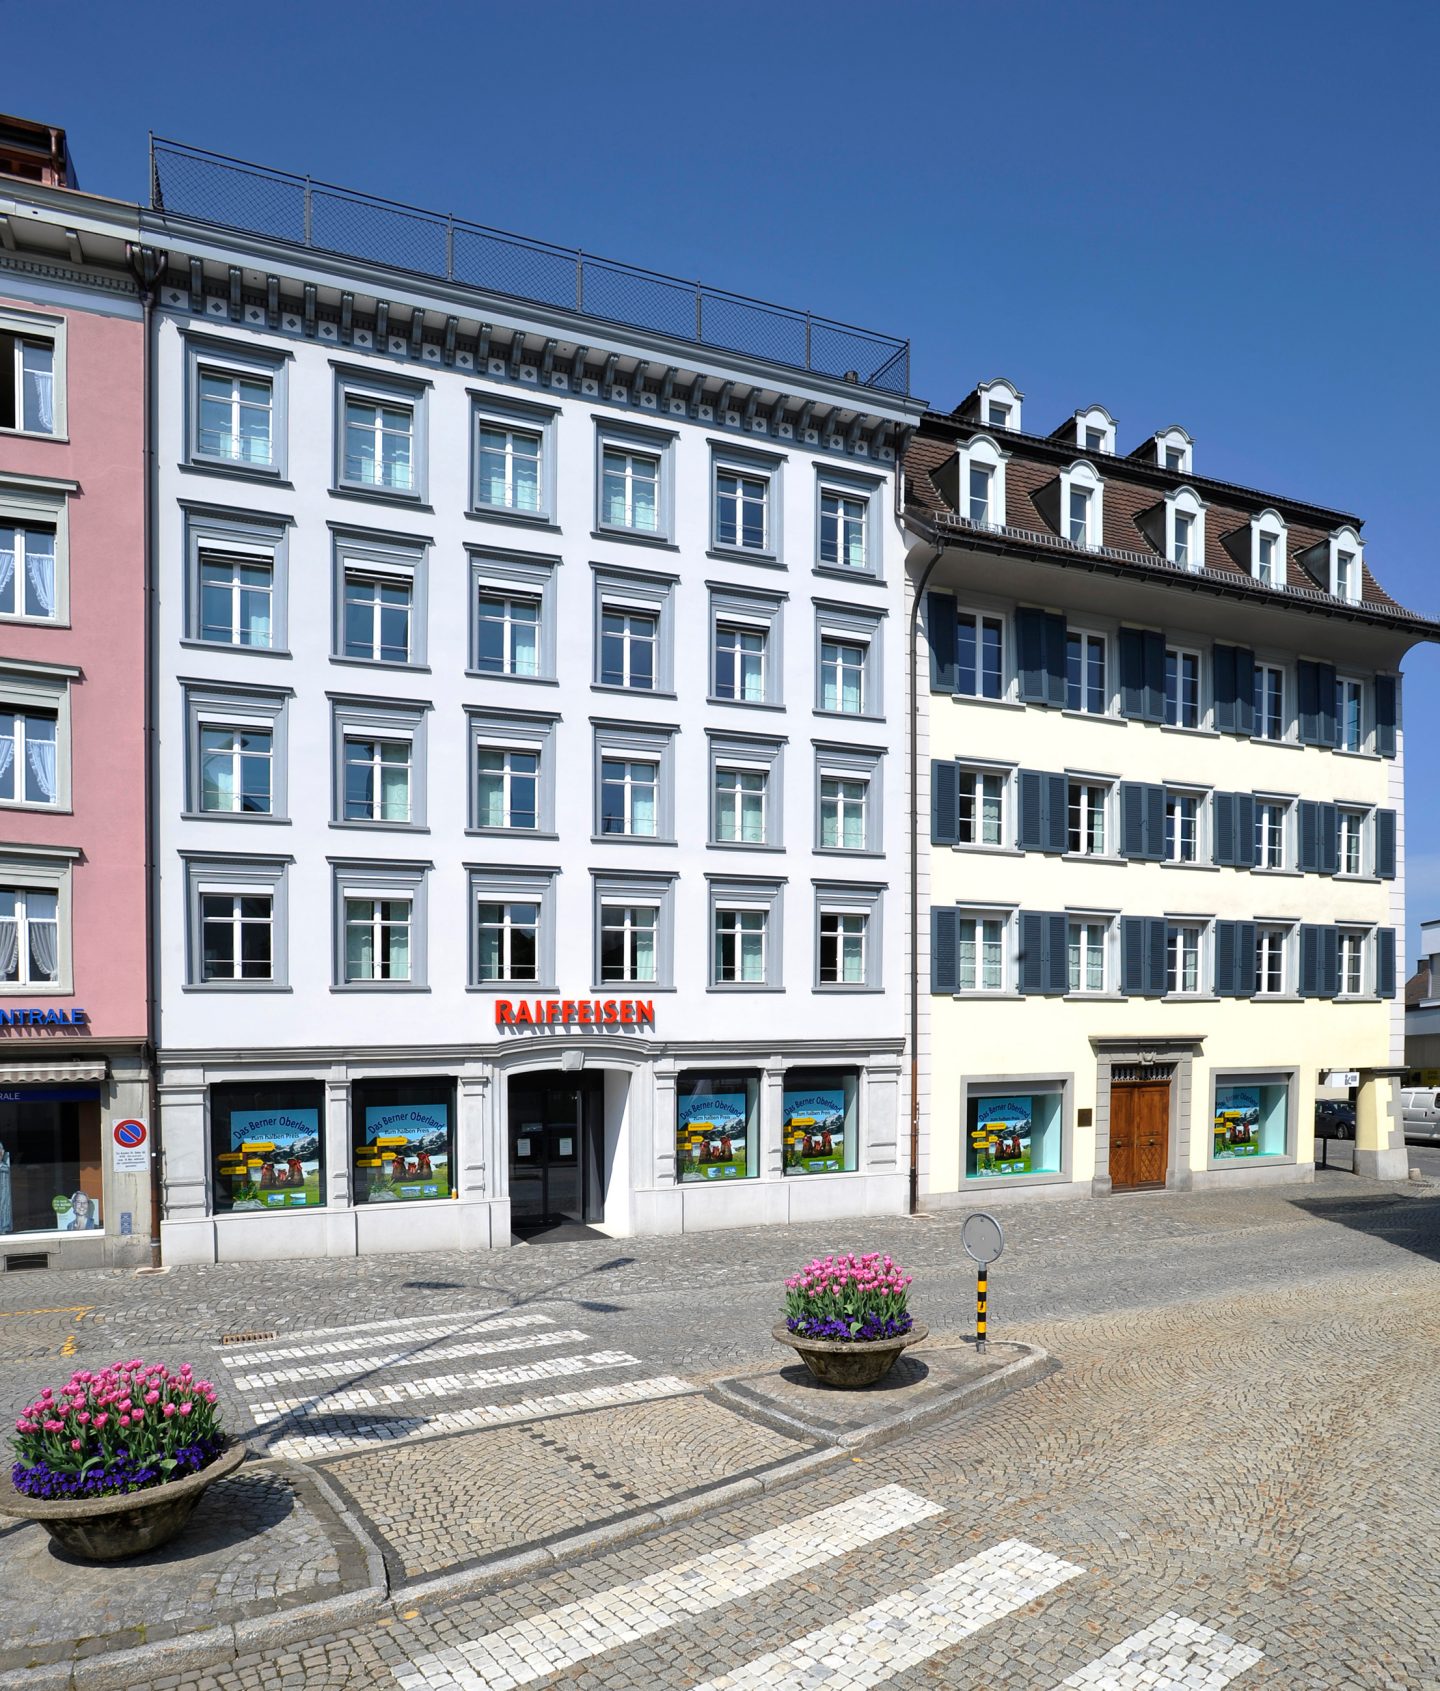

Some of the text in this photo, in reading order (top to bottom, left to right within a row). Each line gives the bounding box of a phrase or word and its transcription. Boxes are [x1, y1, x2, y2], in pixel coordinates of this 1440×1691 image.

[495, 1000, 654, 1024] RAIFFEISEN
[679, 1100, 744, 1121] Das Berner Oberland
[784, 1097, 842, 1117] Das Berner Oberland
[979, 1103, 1030, 1121] Das Berner Oberland
[233, 1116, 316, 1140] Das Berner Oberland
[367, 1111, 445, 1134] Das Berner Oberland
